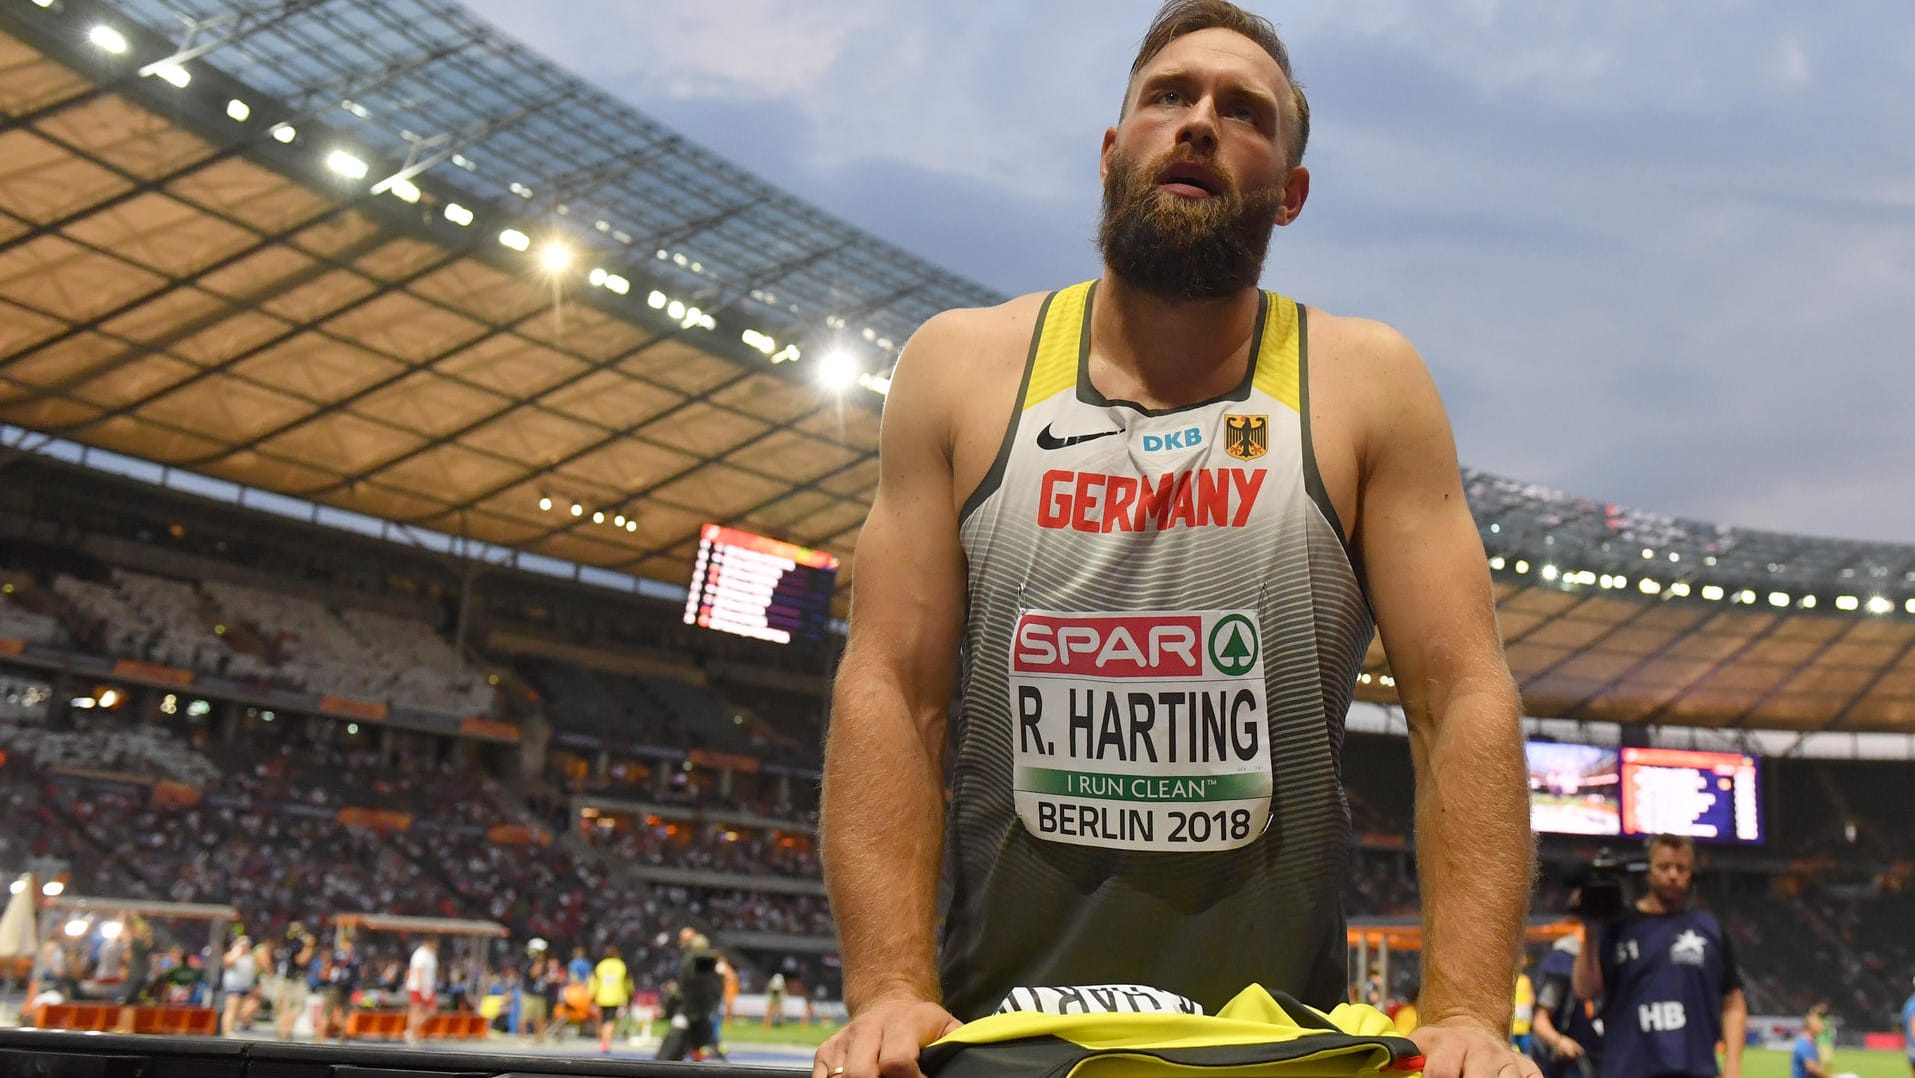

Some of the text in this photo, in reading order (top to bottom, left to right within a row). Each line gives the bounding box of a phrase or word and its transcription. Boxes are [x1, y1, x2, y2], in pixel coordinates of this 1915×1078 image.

[1142, 427, 1202, 452] DKB
[1037, 468, 1267, 534] GERMANY
[1018, 623, 1197, 668] SPAR
[1018, 685, 1259, 763] R. HARTING
[1067, 774, 1072, 793] I
[1079, 776, 1124, 797] RUN
[1038, 801, 1251, 843] BERLIN 2018
[1638, 1000, 1687, 1032] HB
